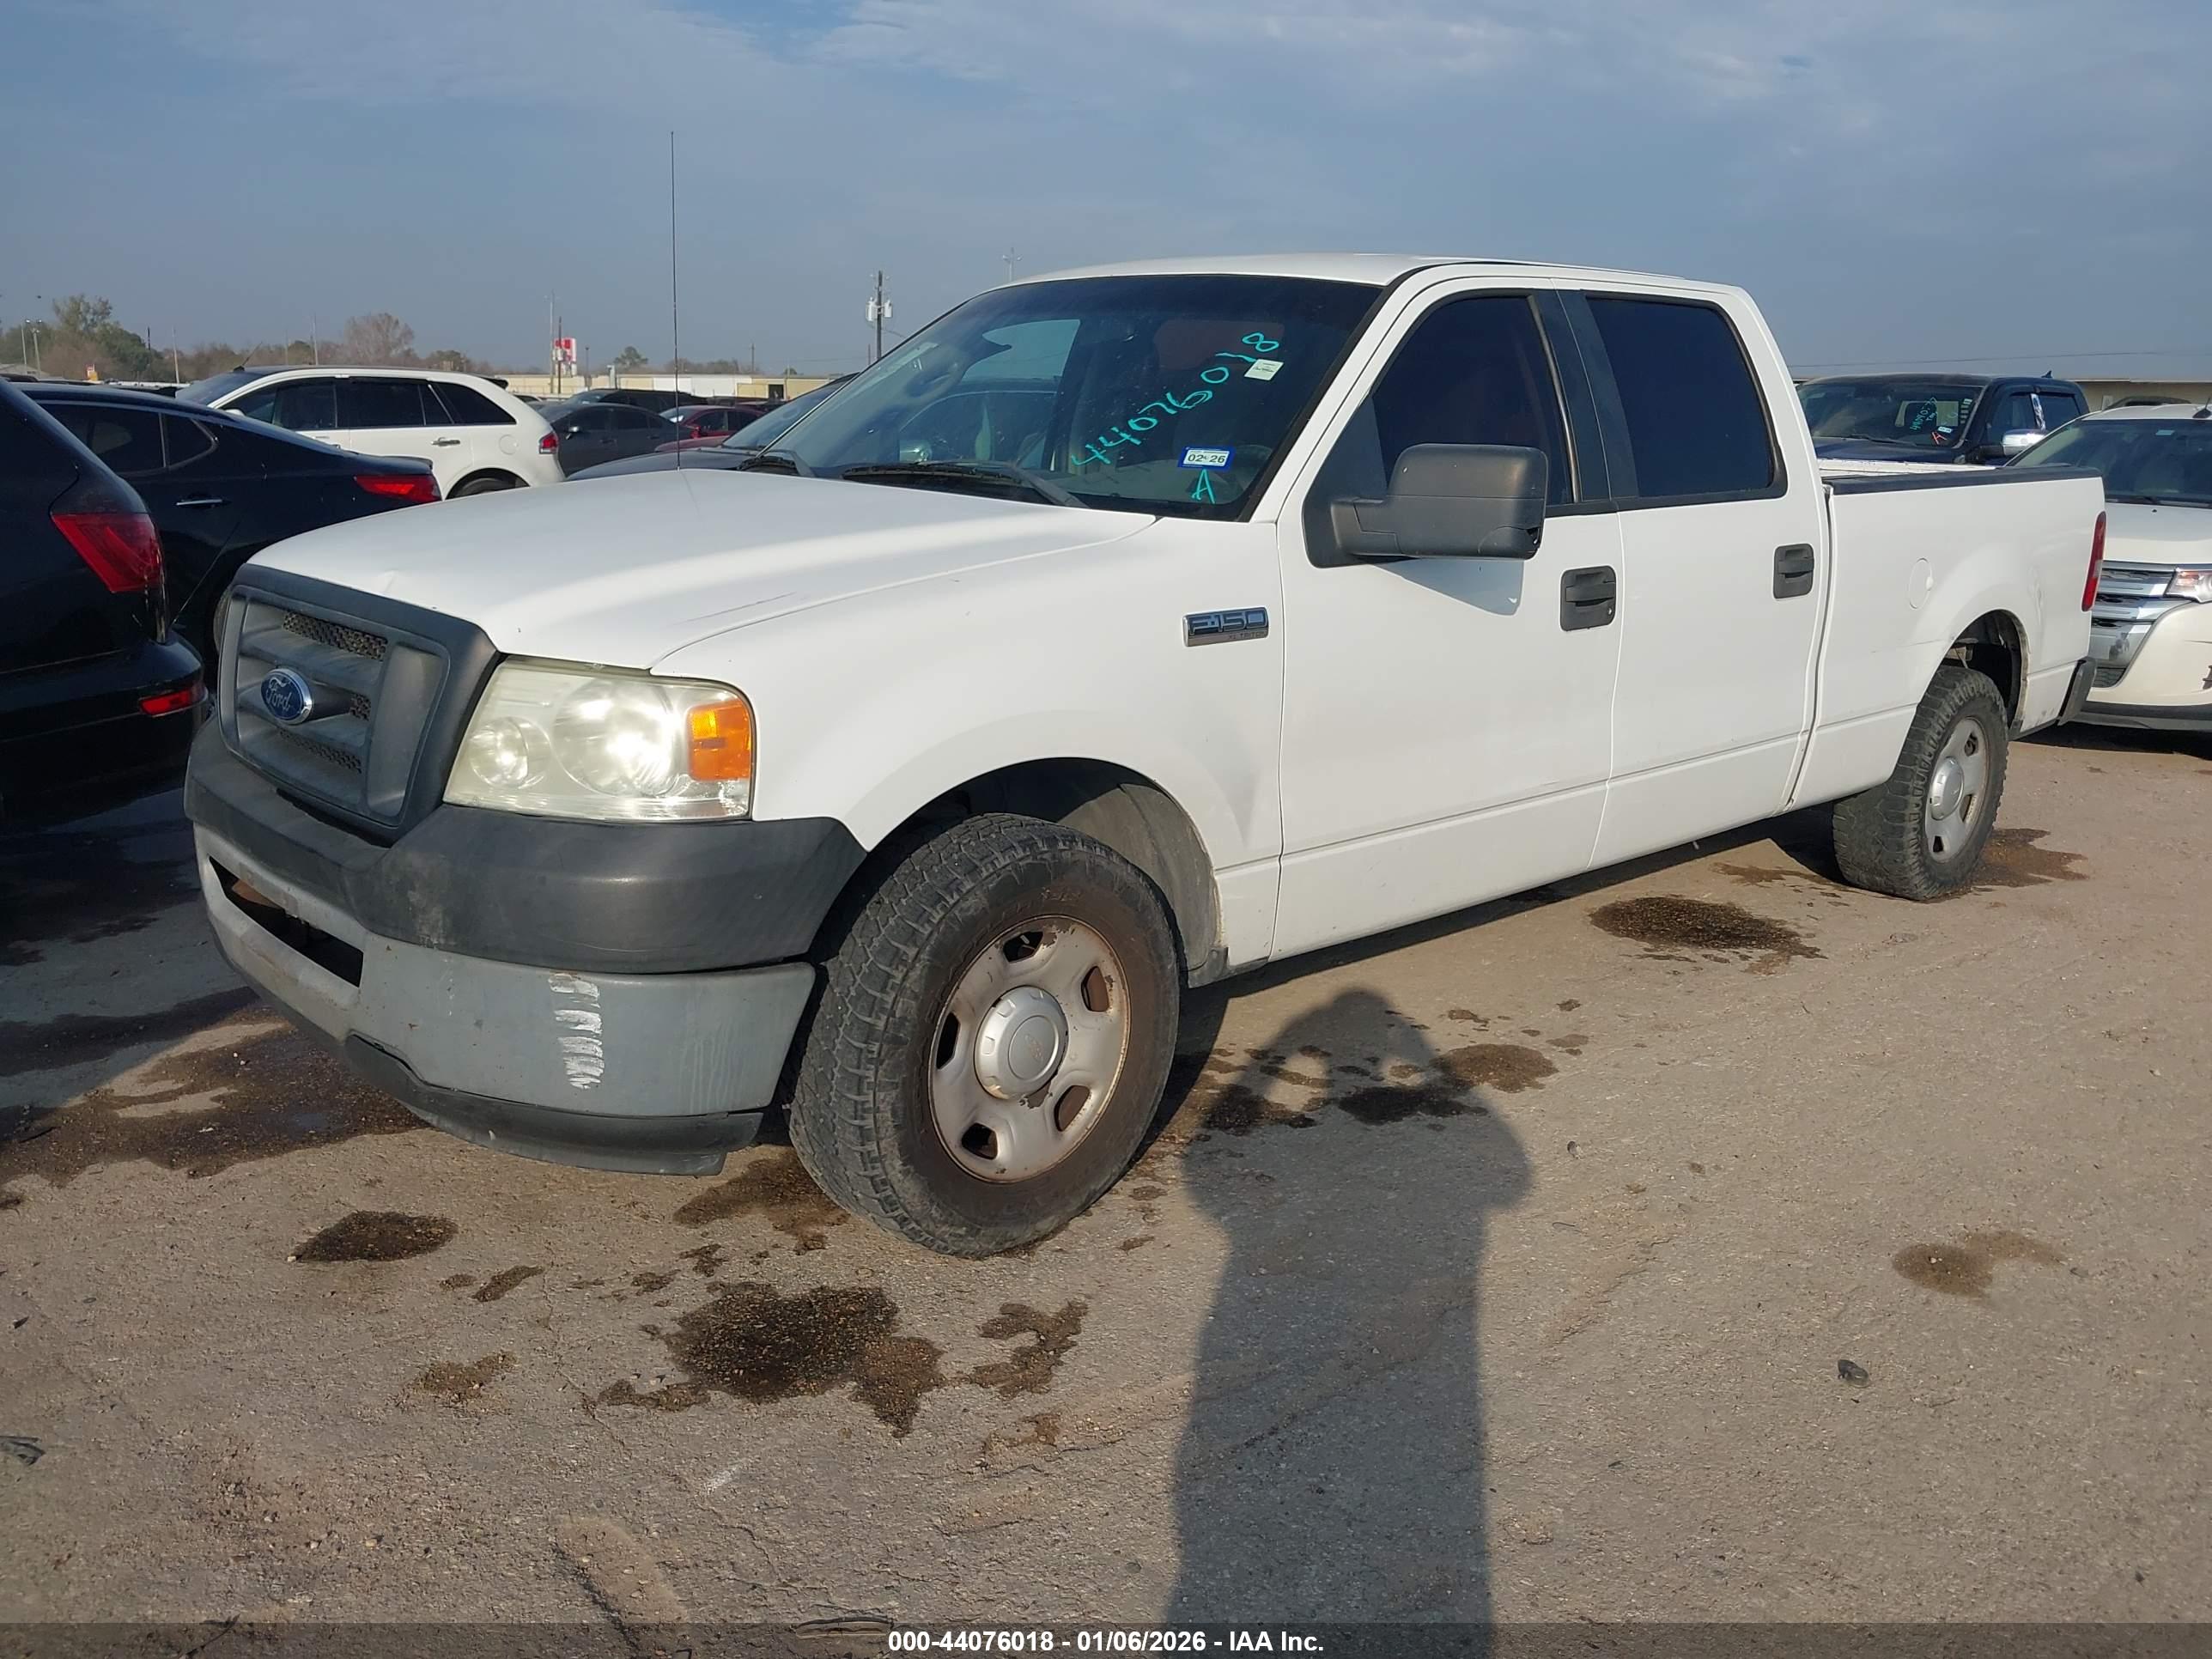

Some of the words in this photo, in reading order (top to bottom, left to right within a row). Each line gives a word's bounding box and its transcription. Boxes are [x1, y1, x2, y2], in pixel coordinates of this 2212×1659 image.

[1071, 331, 1279, 466] 44076018
[1931, 431, 1948, 445] A
[1188, 453, 1204, 462] 02
[1209, 454, 1226, 464] 26
[1191, 469, 1215, 504] A
[265, 677, 293, 712] Ford
